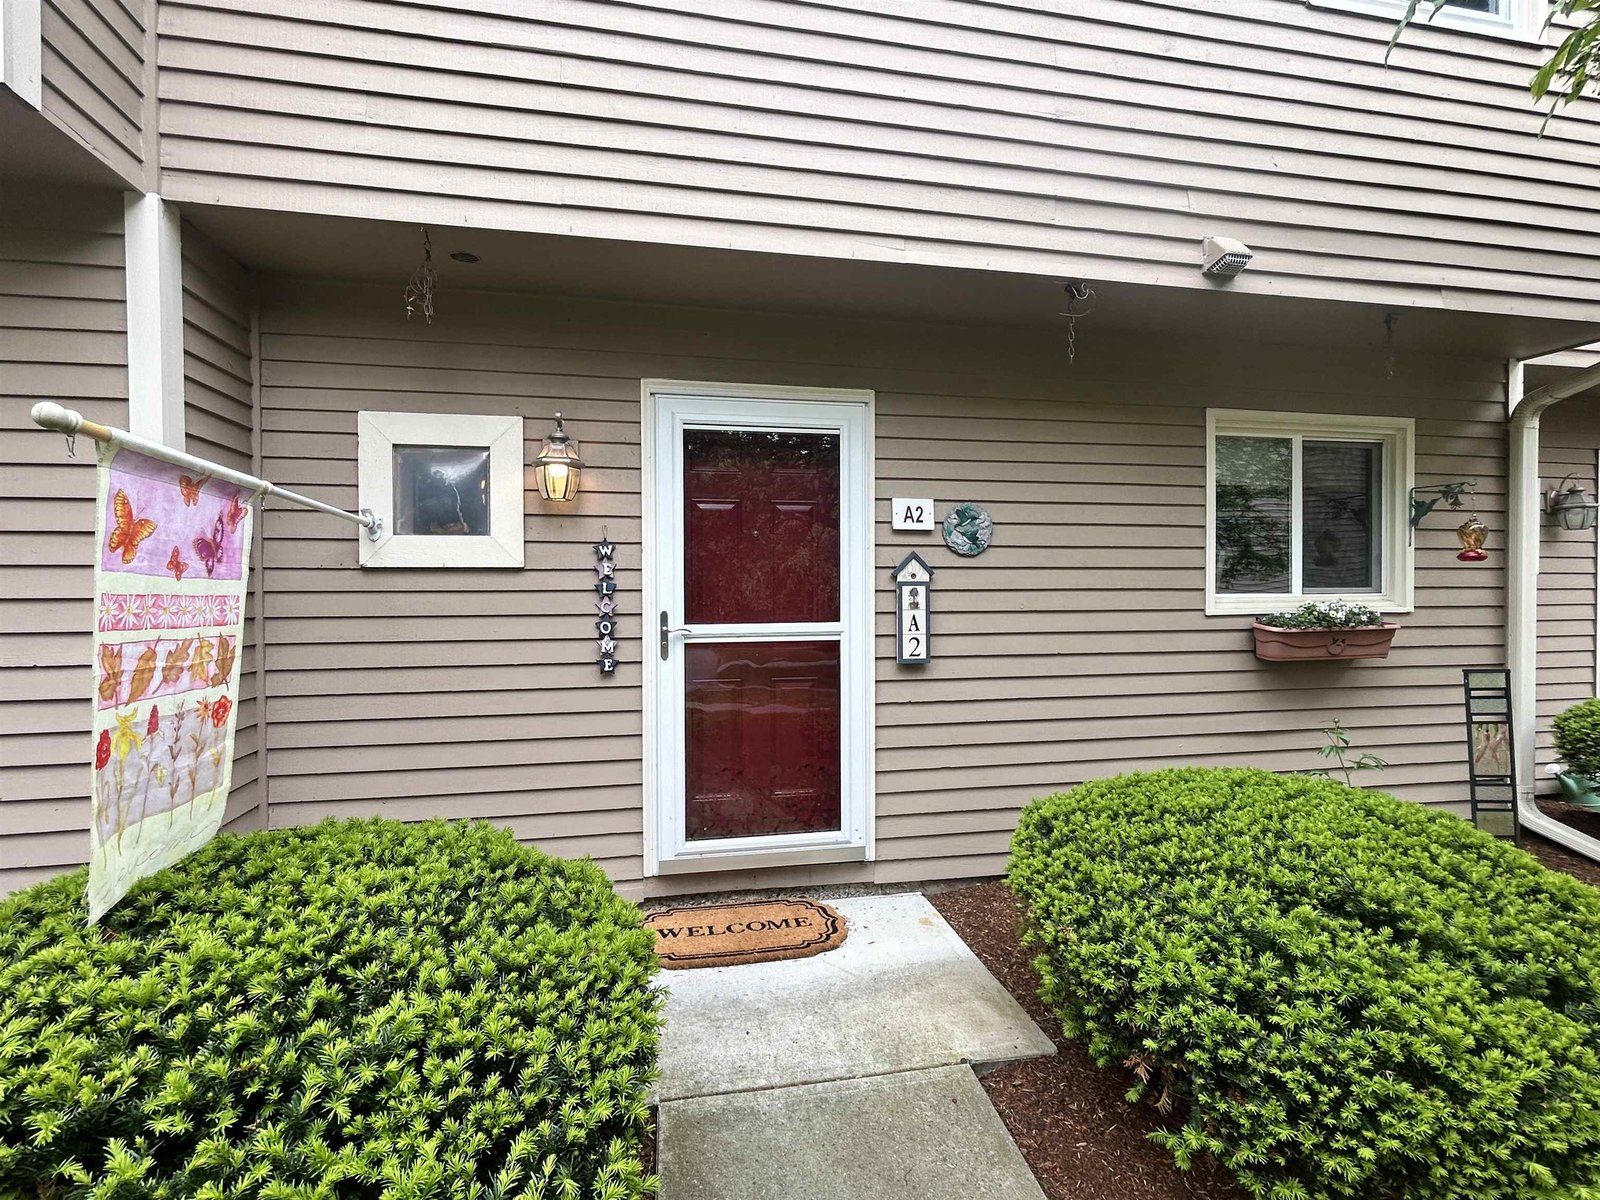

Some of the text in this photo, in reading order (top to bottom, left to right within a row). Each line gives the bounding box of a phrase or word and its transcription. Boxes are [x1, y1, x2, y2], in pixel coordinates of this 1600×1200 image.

[904, 505, 924, 524] A2
[599, 545, 613, 671] WELCOME
[657, 916, 813, 939] WELCOME
